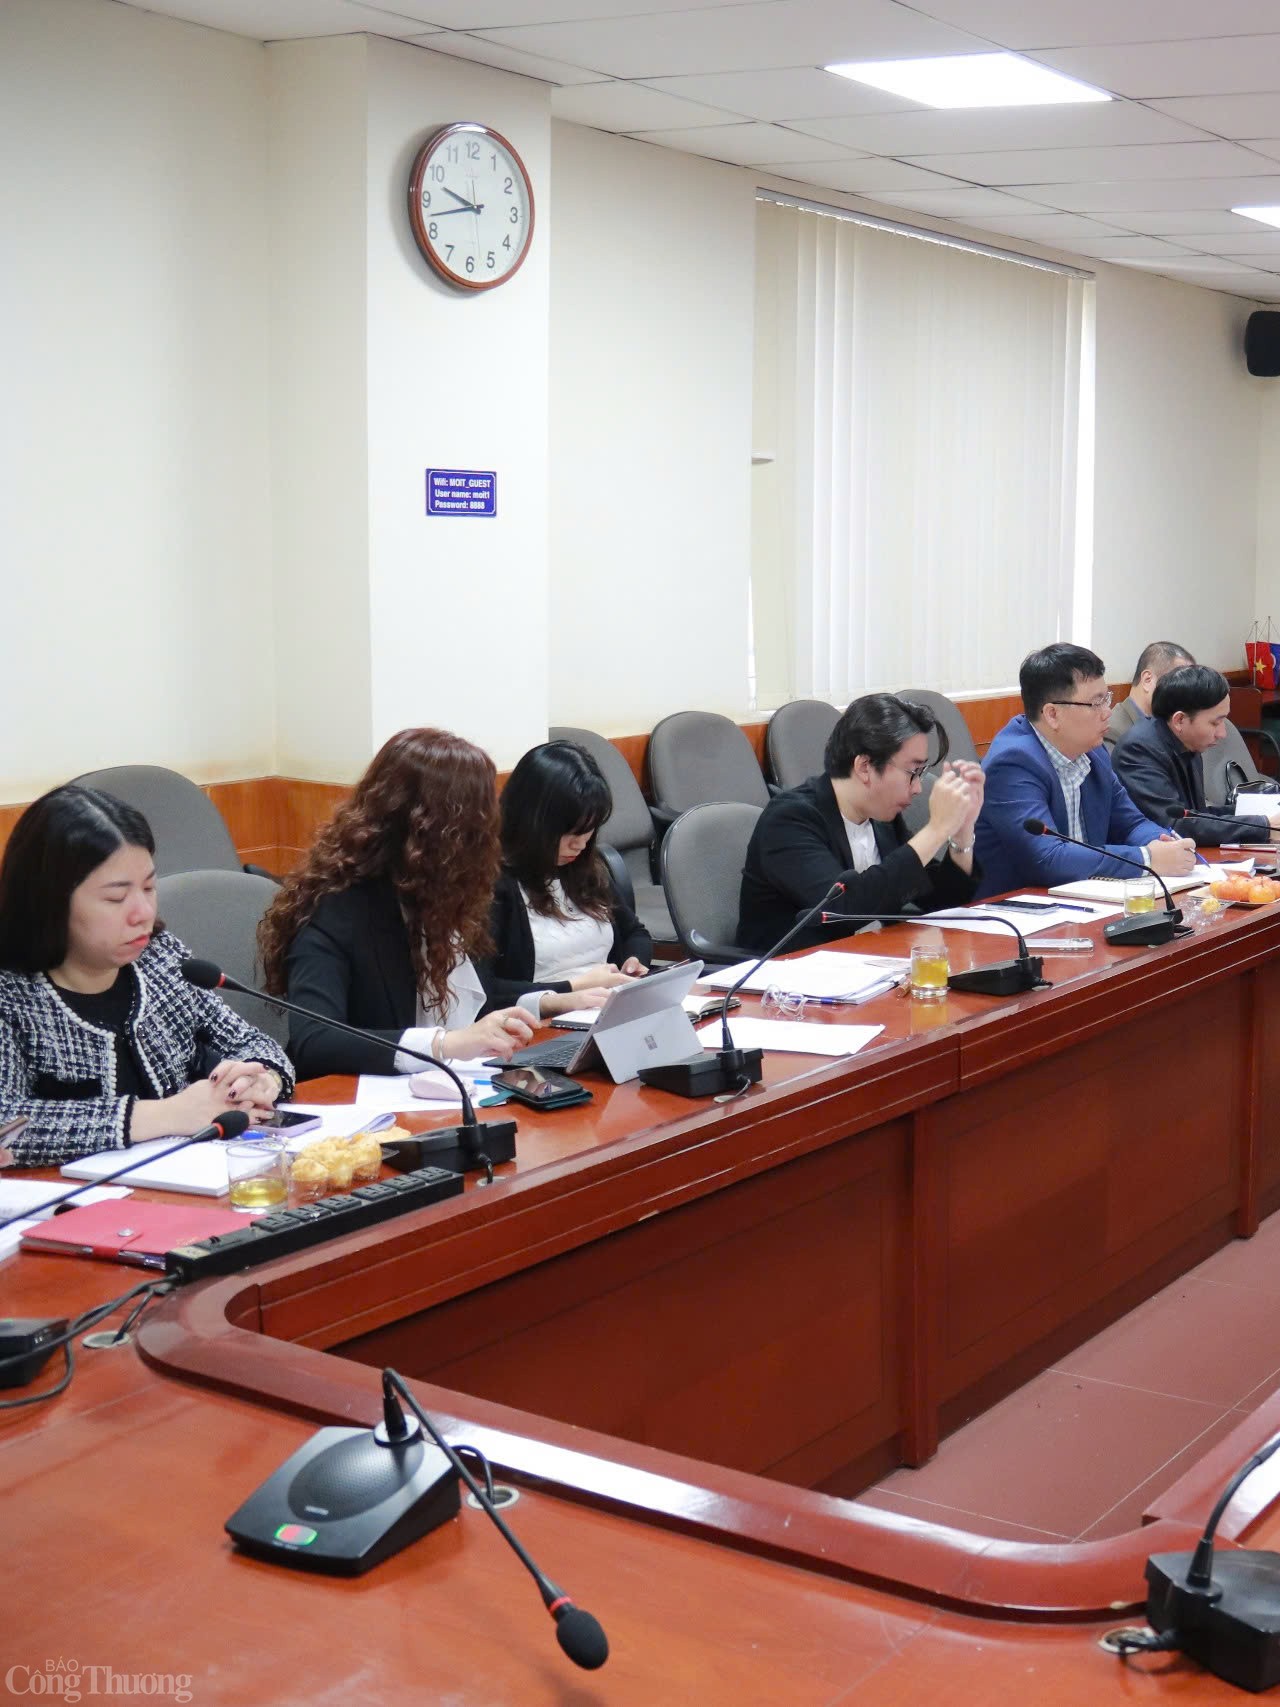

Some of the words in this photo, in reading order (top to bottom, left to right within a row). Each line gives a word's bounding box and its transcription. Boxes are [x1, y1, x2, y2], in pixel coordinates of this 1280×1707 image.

[447, 144, 459, 164] 11
[466, 142, 480, 160] 12
[491, 154, 497, 171] 1
[430, 164, 445, 183] 10
[504, 177, 513, 195] 2
[422, 190, 431, 209] 9
[509, 207, 518, 224] 3
[429, 222, 438, 240] 8
[502, 234, 511, 251] 4
[445, 244, 455, 262] 7
[486, 251, 496, 268] 5
[466, 256, 475, 273] 6
[449, 479, 491, 488] MOIT_GUEST
[435, 489, 450, 497] User
[435, 500, 468, 508] Password:
